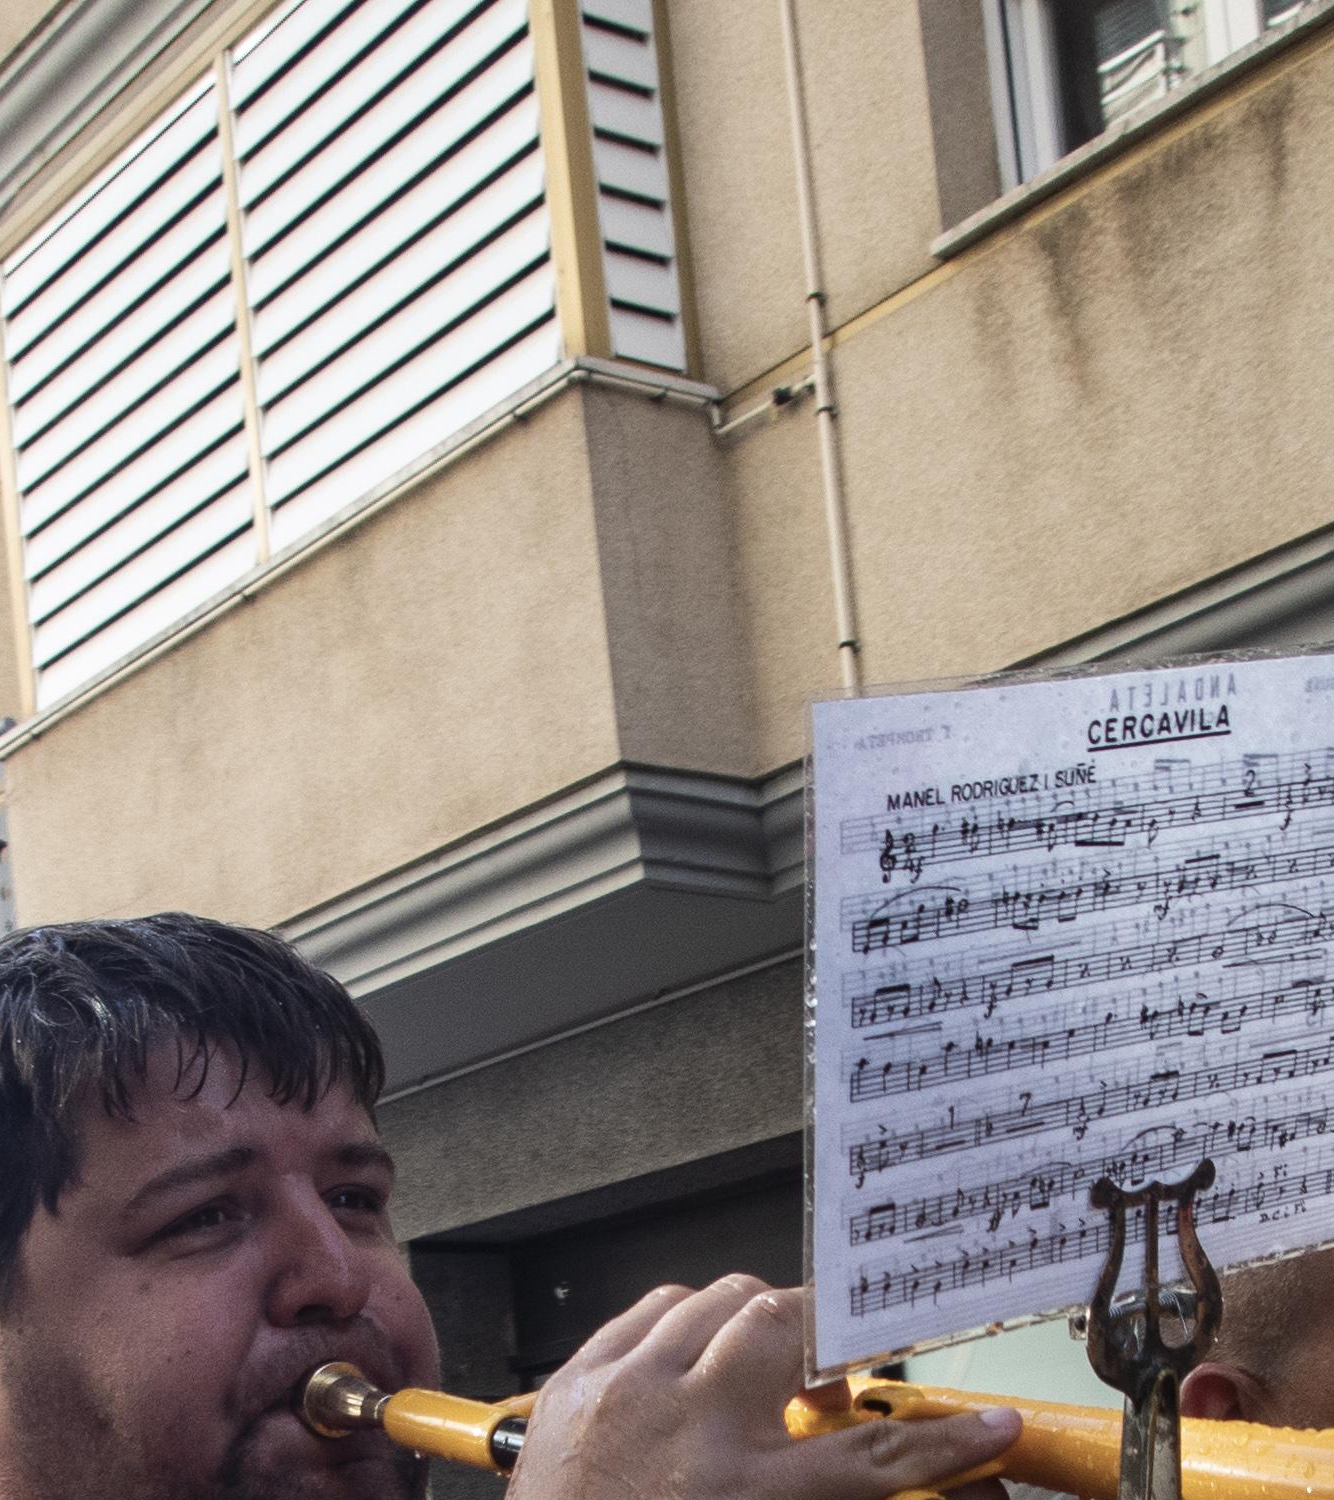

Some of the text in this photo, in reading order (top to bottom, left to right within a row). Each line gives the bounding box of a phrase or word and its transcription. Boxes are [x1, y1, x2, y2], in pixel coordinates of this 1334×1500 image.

[1087, 704, 1230, 745] CERCAVILA
[887, 787, 945, 811] MANEL
[951, 772, 1040, 801] RODRIGUEZ
